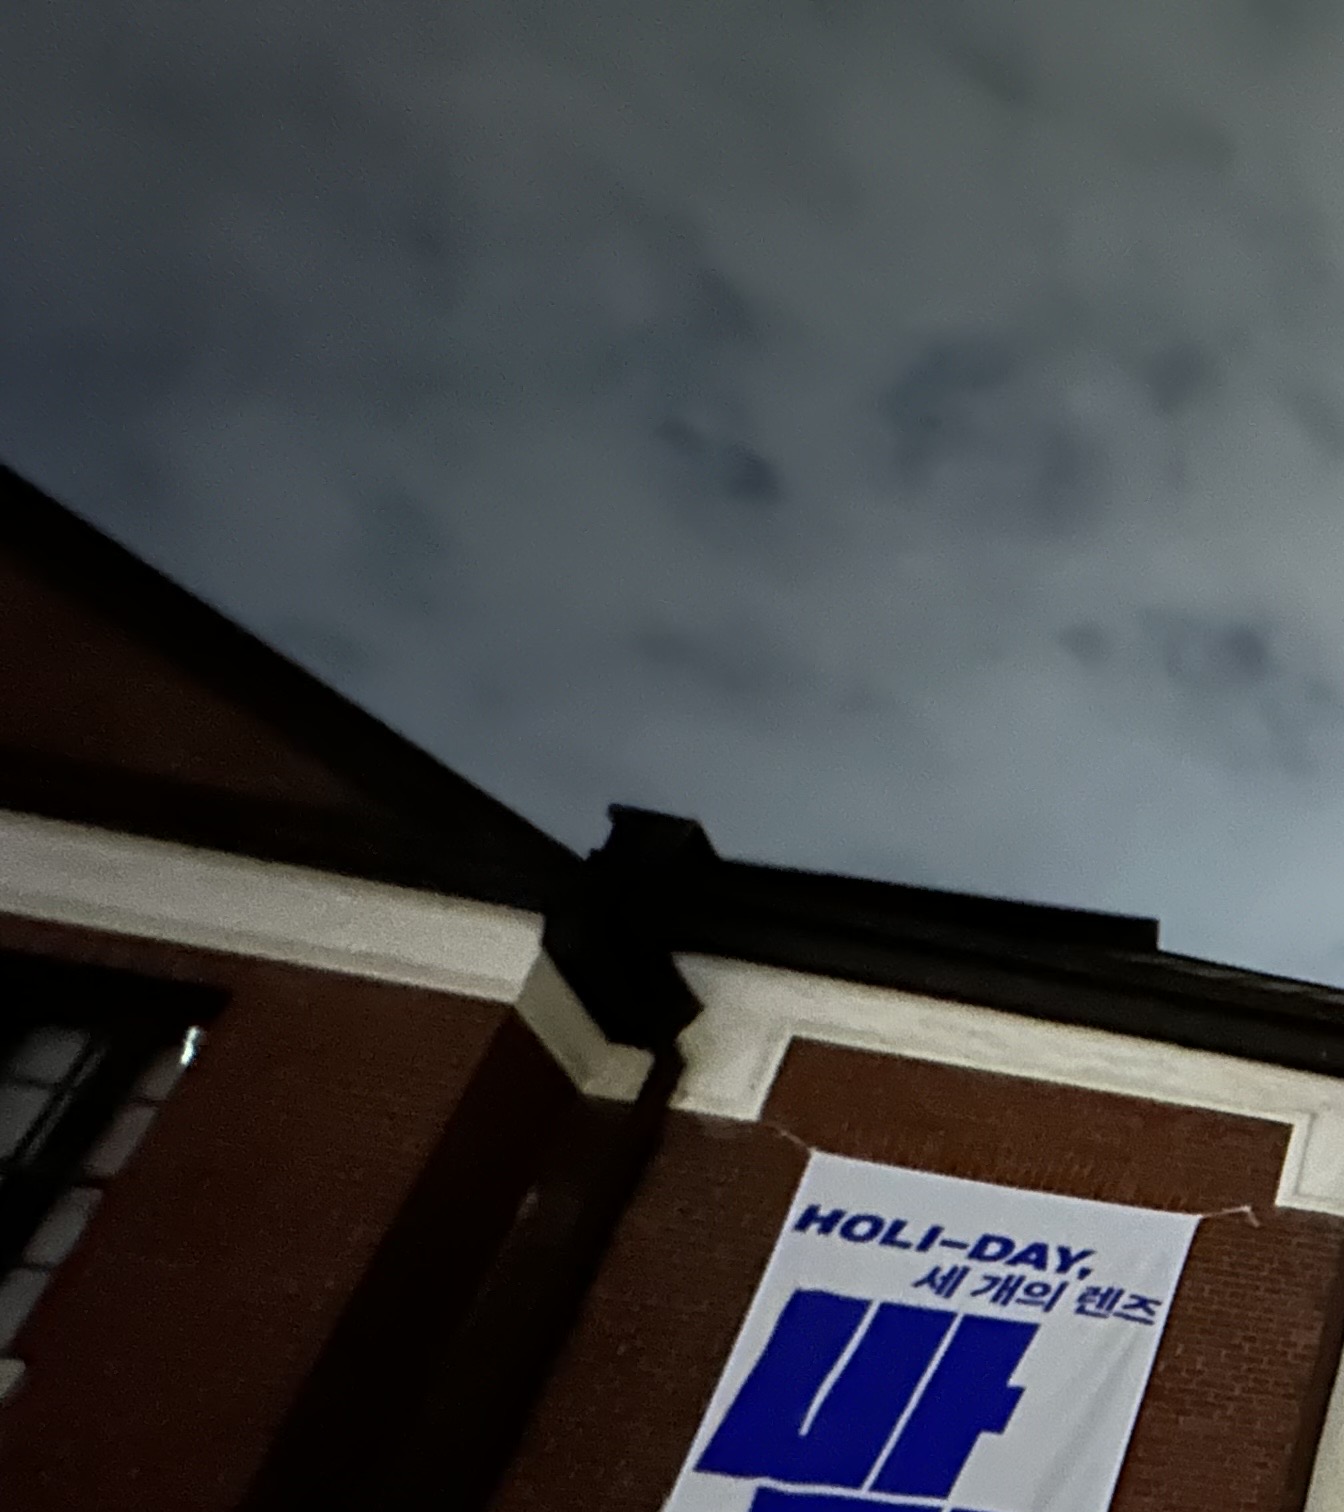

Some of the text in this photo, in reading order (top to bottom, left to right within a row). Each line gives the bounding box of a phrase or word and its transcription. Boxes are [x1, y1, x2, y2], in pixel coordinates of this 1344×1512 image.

[793, 1204, 1095, 1280] HOLI-DAY,
[913, 1265, 1163, 1326] 세 개의 렌즈
